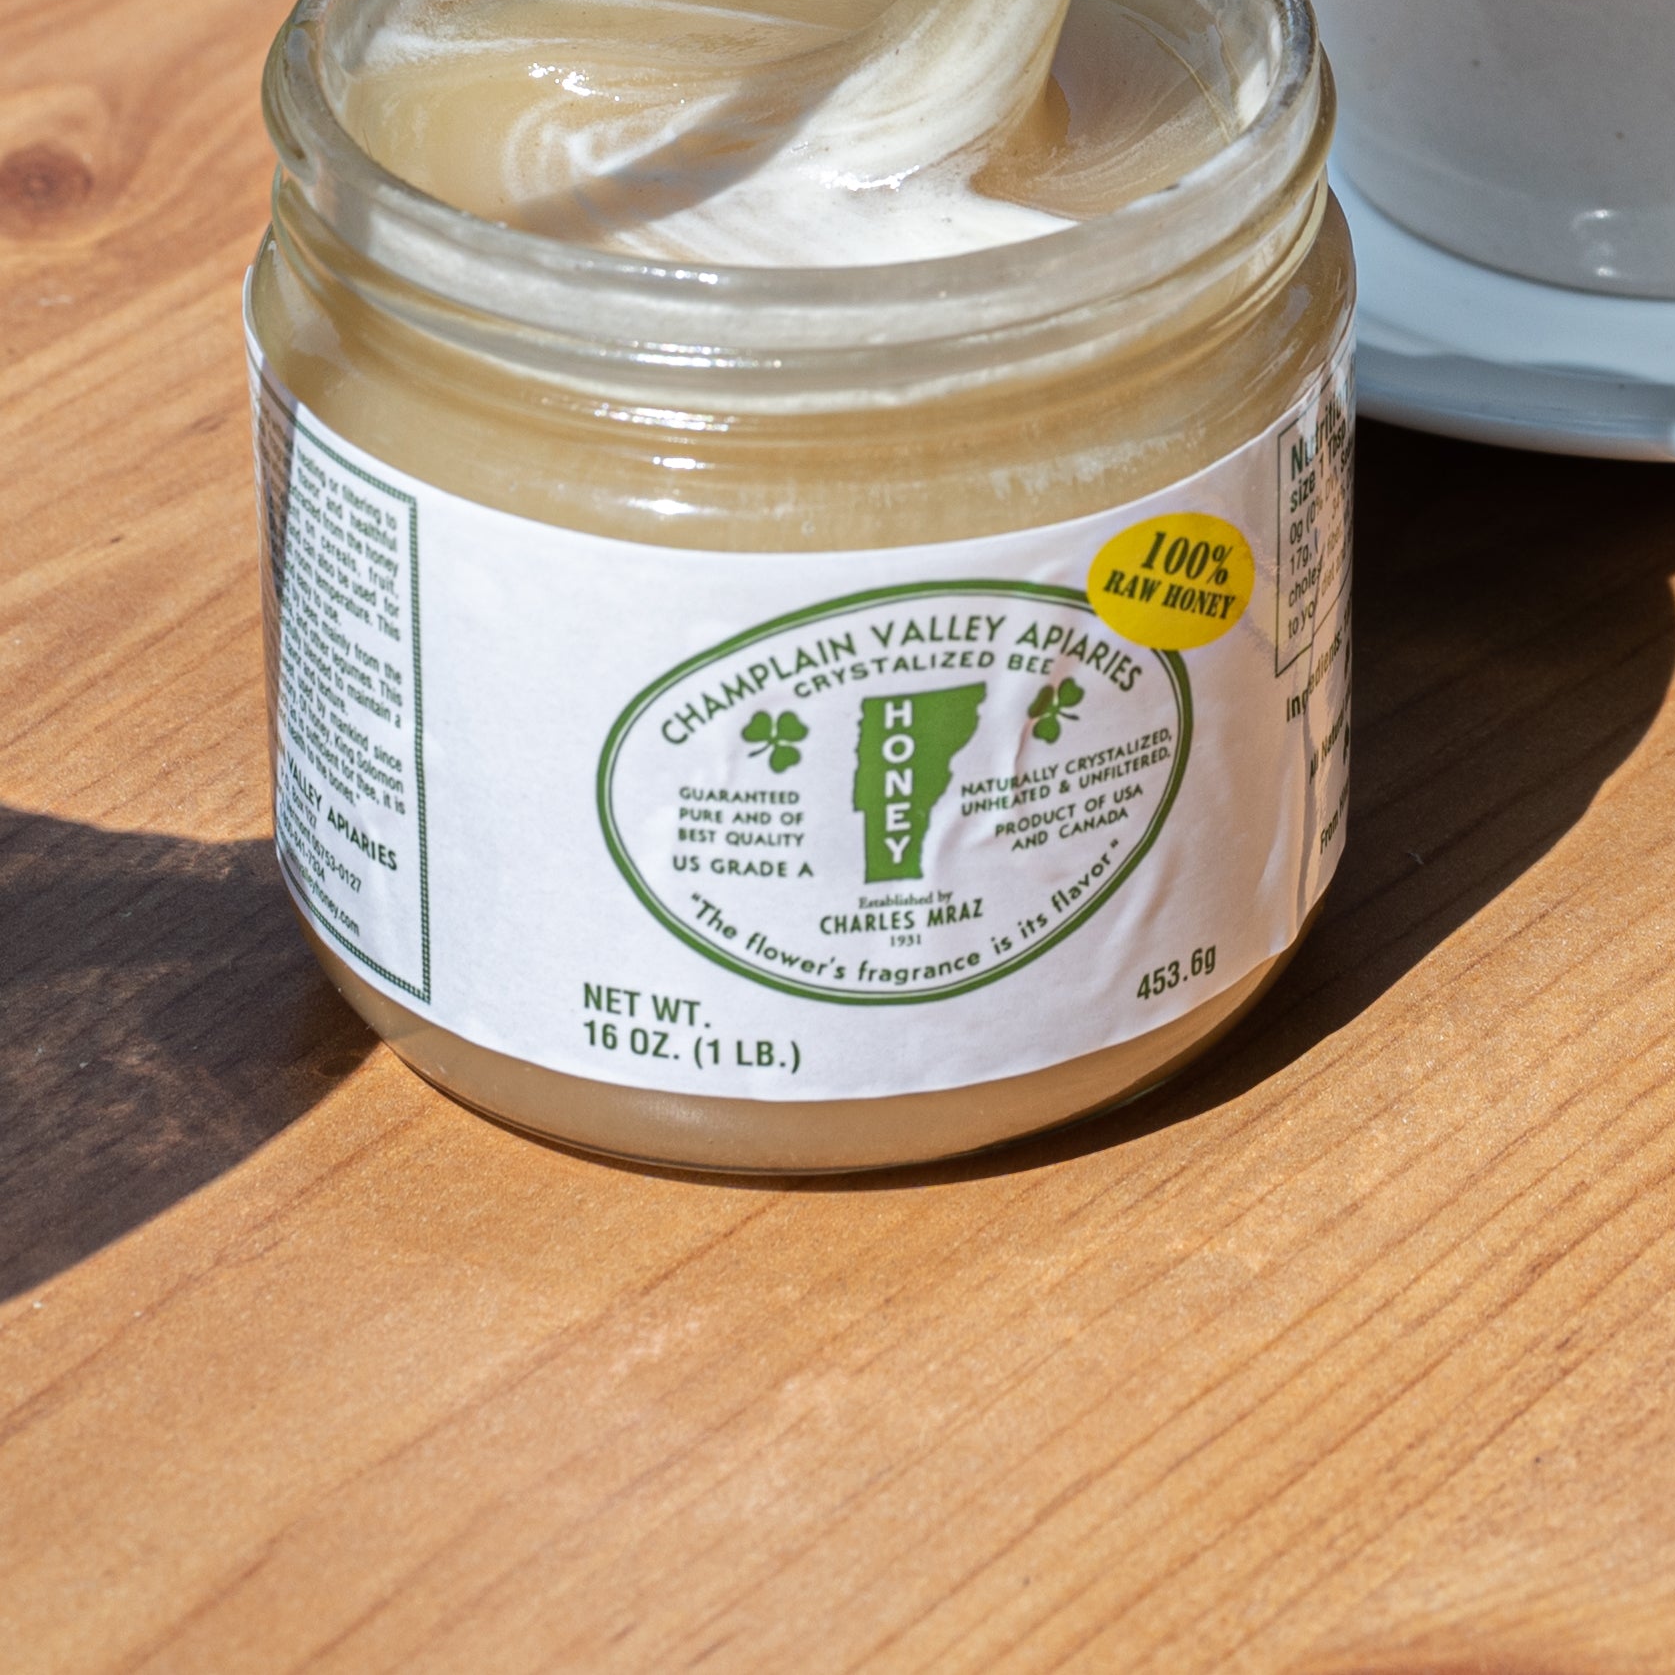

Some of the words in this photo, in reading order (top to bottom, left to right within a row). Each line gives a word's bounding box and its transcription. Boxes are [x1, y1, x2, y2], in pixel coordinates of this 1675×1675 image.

[1291, 469, 1315, 513] size
[350, 511, 397, 553] healthful
[385, 512, 397, 531] to
[347, 531, 362, 555] the
[366, 542, 398, 578] honey
[1141, 531, 1233, 586] 100%
[315, 569, 373, 626] temperature.
[376, 613, 401, 641] This
[352, 581, 377, 607] used
[384, 596, 400, 618] for
[369, 566, 399, 599] fruit,
[1103, 569, 1162, 604] RAW
[1162, 583, 1236, 620] HONEY
[332, 647, 375, 691] legumes.
[379, 678, 402, 707] This
[355, 642, 380, 673] from
[384, 662, 401, 686] the
[661, 631, 858, 746] CHAMPLAIN
[871, 614, 1006, 649] VALLEY
[1015, 620, 1144, 692] APIARIES
[793, 650, 995, 699] CRYSTALIZED
[1007, 653, 1055, 676] BEE
[1287, 626, 1342, 722] Ingedients:
[347, 684, 391, 724] maintain
[394, 713, 402, 729] a
[330, 711, 369, 752] mankind
[374, 745, 402, 773] since
[334, 733, 355, 765] King
[357, 751, 404, 794] Solomon
[960, 763, 1060, 798] NATURALLY
[1065, 727, 1173, 775] CRYSTALIZED,
[342, 760, 354, 782] for
[357, 773, 379, 805] thee,
[395, 795, 405, 815] is
[678, 785, 800, 805] GUARANTEED
[881, 698, 916, 864] HONEY
[960, 785, 1051, 818] UNHEATED
[1058, 779, 1070, 794] &
[1079, 746, 1171, 789] UNFILTERED.
[287, 751, 322, 811] VALLEY
[328, 806, 398, 872] APIARIES
[678, 806, 723, 824] PURE
[731, 810, 772, 826] AND
[780, 811, 805, 826] OF
[995, 803, 1076, 838] PRODUCT
[1084, 793, 1107, 813] OF
[1113, 783, 1144, 803] USA
[1011, 830, 1049, 852] AND
[1058, 807, 1129, 839] CANADA
[677, 827, 717, 844] BEST
[725, 830, 805, 847] QUALITY
[672, 855, 700, 873] US
[710, 858, 787, 878] GRADE
[797, 861, 815, 878] A
[819, 910, 915, 936] CHARLES
[928, 898, 984, 928] MRAZ
[858, 892, 933, 910] Established
[937, 890, 953, 905] by
[745, 932, 846, 980] flower's
[857, 951, 981, 986] fragrance
[990, 935, 1012, 957] is
[1017, 911, 1048, 940] its
[890, 933, 922, 948] 1931
[1137, 944, 1216, 1000] 453.6g
[584, 982, 641, 1017] NET
[651, 994, 711, 1028] WT.
[584, 1019, 618, 1050] 16
[630, 1027, 680, 1060] OZ.
[694, 1036, 720, 1069] (1
[736, 1040, 802, 1074] LB.)
